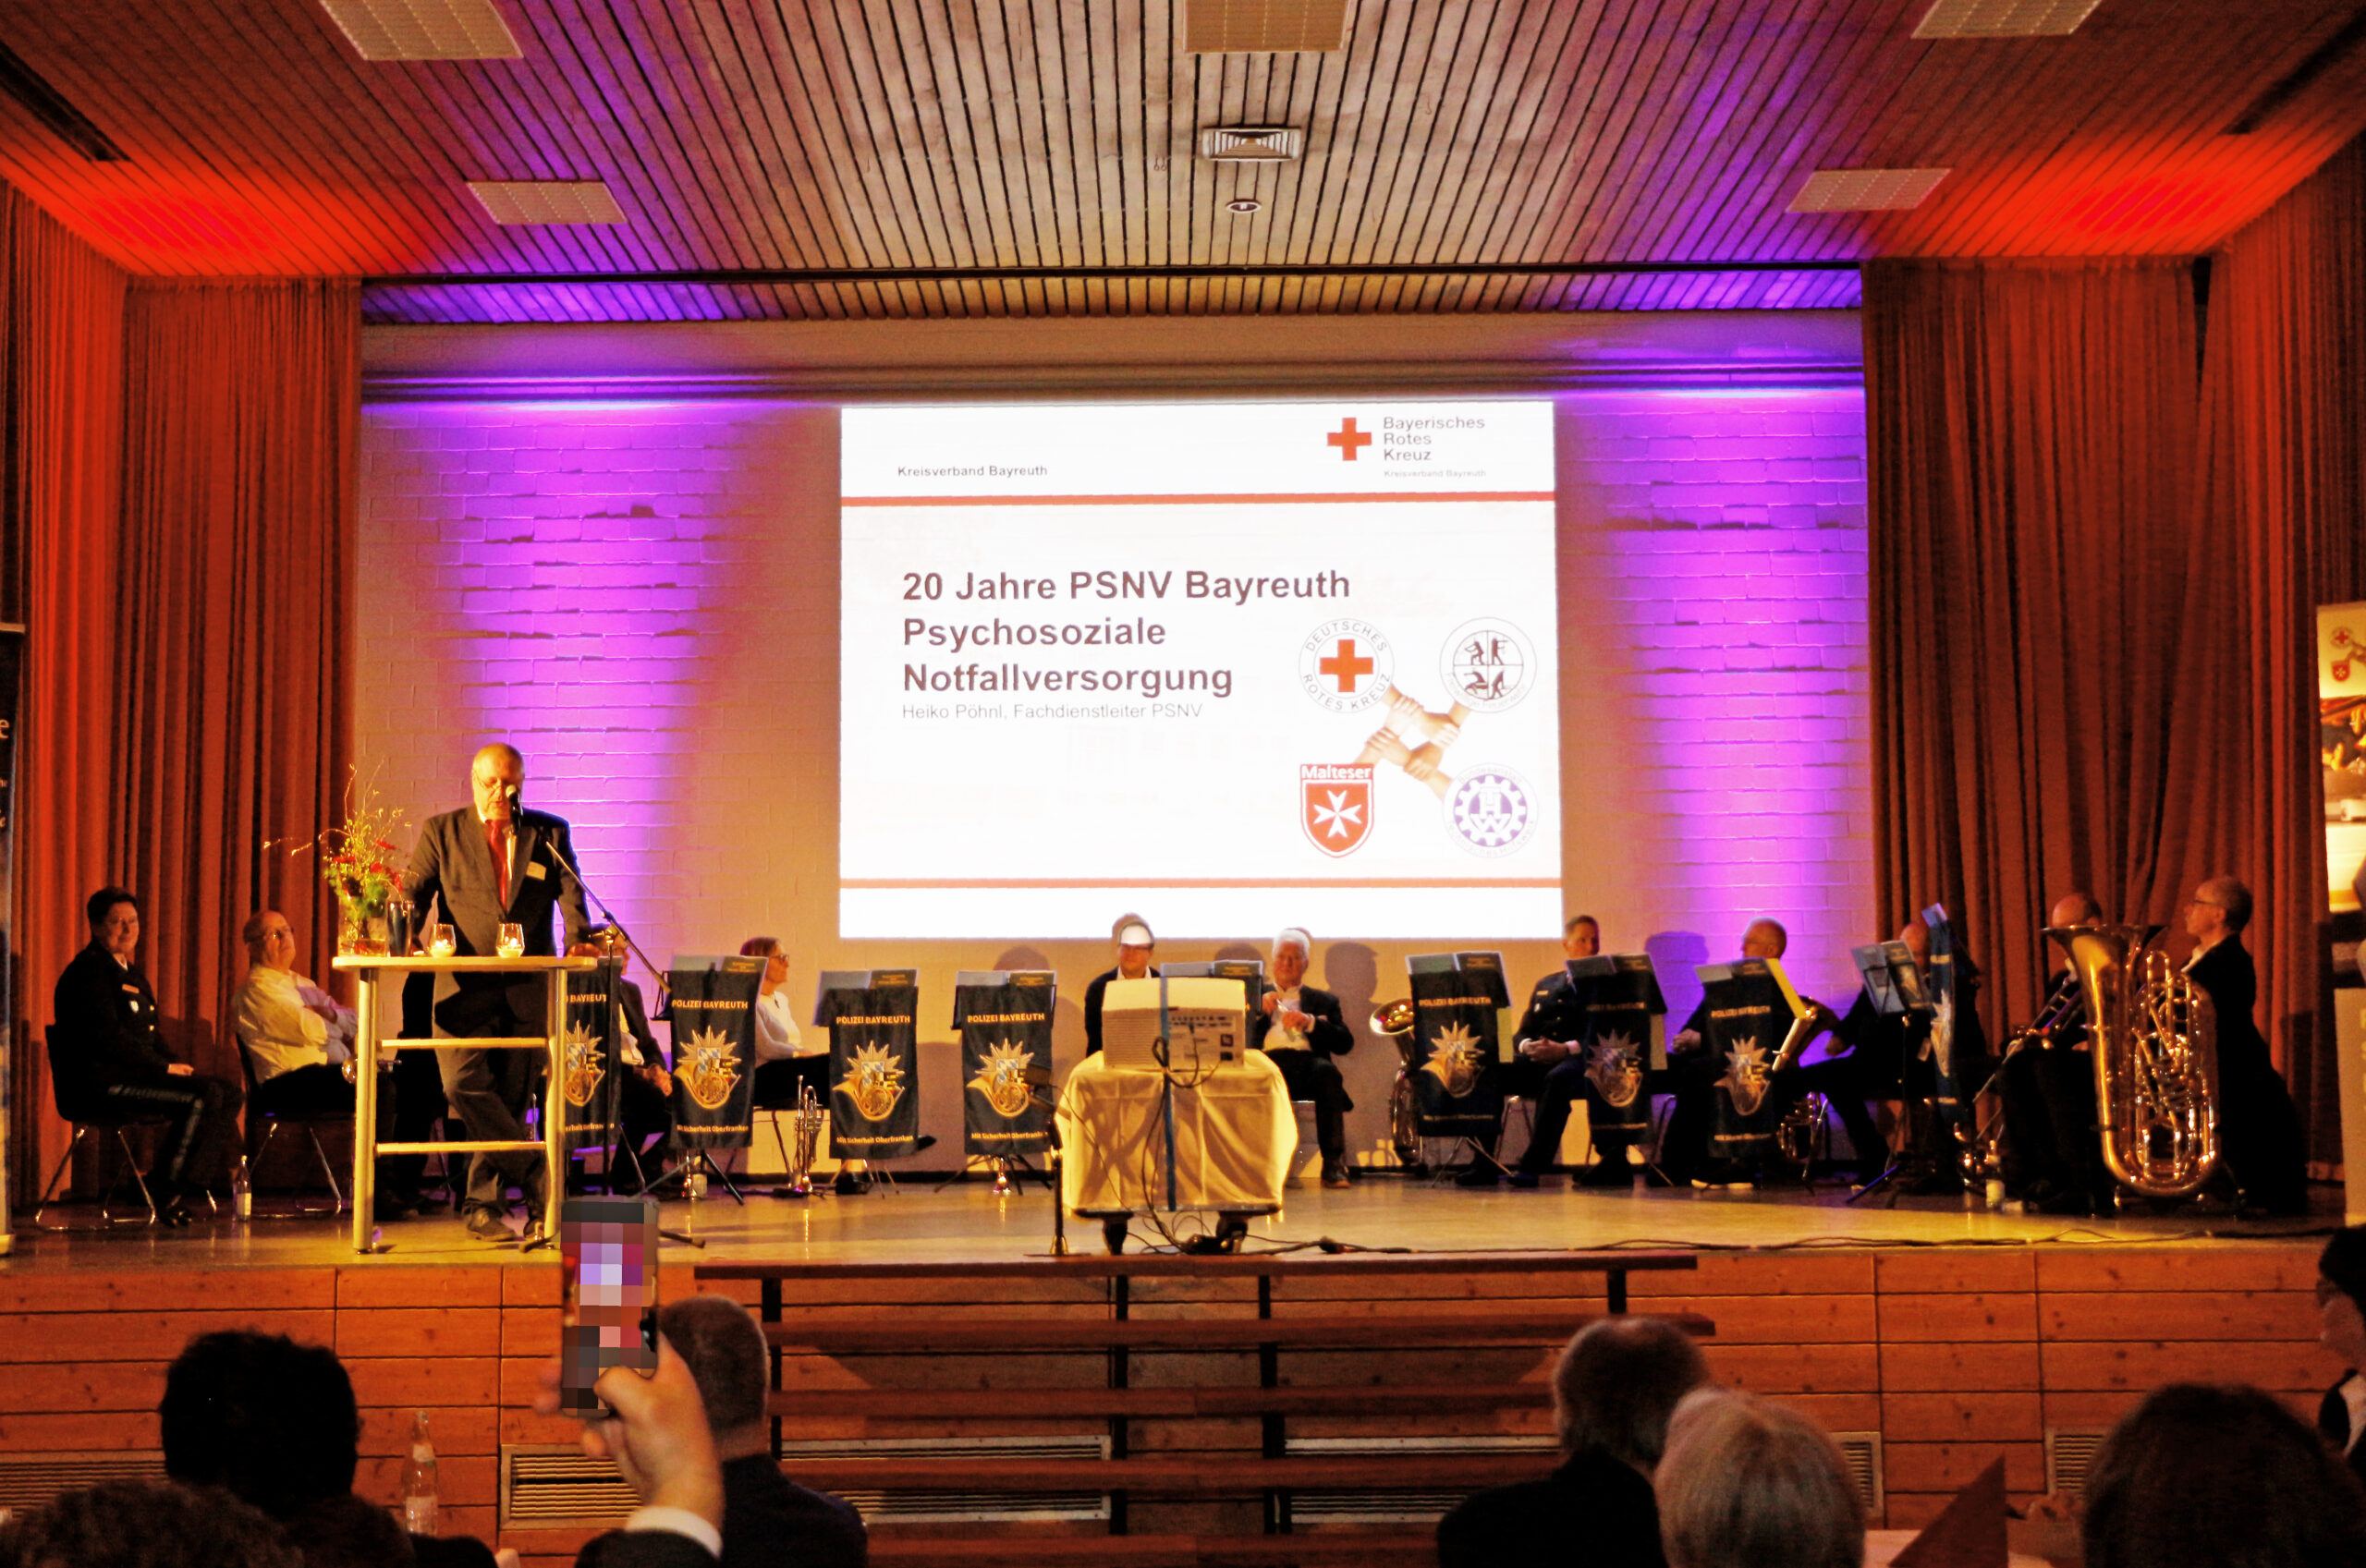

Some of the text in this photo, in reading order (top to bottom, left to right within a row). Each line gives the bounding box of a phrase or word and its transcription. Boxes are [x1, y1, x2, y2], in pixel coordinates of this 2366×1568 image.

[1384, 416, 1485, 432] Bayerisches
[1384, 432, 1432, 445] Rotes
[1384, 448, 1432, 461] Kreuz
[897, 465, 1047, 478] Kreisverband Bayreuth
[1445, 469, 1487, 479] Bayreuth
[902, 569, 1350, 607] 20 Jahre PSNV Bayreuth
[904, 616, 1166, 654] Psychosoziale
[1305, 620, 1388, 651] DEUTSCHES
[904, 662, 1233, 699] Notfallversorgung
[1303, 673, 1391, 711] ROTES KREUZ
[902, 703, 1203, 721] Heiko Pöhnl, Fachdienstleiter PSNV
[1301, 764, 1372, 779] Malteser
[671, 999, 749, 1009] POLIZEI BAYREUTH
[835, 1015, 911, 1025] POLIZEI BAYREUTH
[967, 1012, 1045, 1023] POLIZEI BAYREUTH
